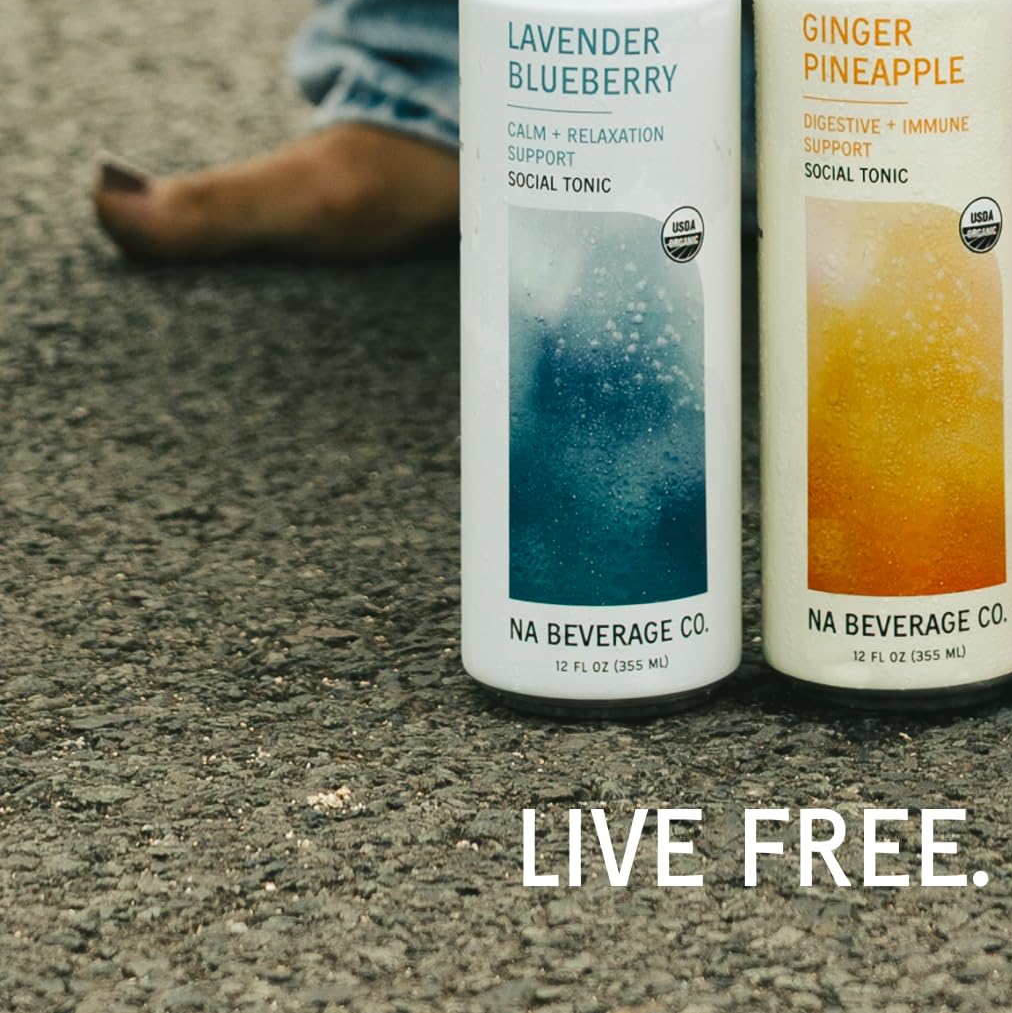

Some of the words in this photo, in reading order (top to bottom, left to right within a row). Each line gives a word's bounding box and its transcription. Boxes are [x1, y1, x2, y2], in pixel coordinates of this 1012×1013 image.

[508, 20, 661, 55] LAVENDER
[802, 12, 913, 46] GINGER
[508, 60, 678, 95] BLUEBERRY
[803, 52, 965, 86] PINEAPPLE
[507, 121, 546, 141] CALM
[567, 126, 665, 144] RELAXATION
[803, 113, 881, 135] DIGESTIVE
[903, 116, 970, 135] IMMUNE
[507, 145, 576, 167] SUPPORT
[803, 137, 872, 157] SUPPORT
[508, 170, 558, 192] SOCIAL
[563, 176, 612, 193] TONIC
[804, 162, 854, 182] SOCIAL
[859, 167, 909, 184] TONIC
[672, 219, 696, 233] USDA
[970, 209, 994, 224] USDA
[510, 617, 538, 644] NA
[547, 619, 673, 647] BEVERAGE
[680, 612, 709, 638] CO.
[808, 607, 837, 634] NA
[845, 609, 970, 637] BEVERAGE
[978, 602, 1007, 628] CO.
[556, 660, 568, 672] 12
[574, 661, 588, 673] FL
[592, 661, 609, 673] OZ
[614, 659, 643, 674] (355
[648, 655, 669, 669] ML)
[853, 650, 865, 662] 12
[871, 651, 885, 663] FL
[889, 651, 906, 663] OZ
[911, 649, 940, 663] (355
[945, 644, 966, 659] ML)
